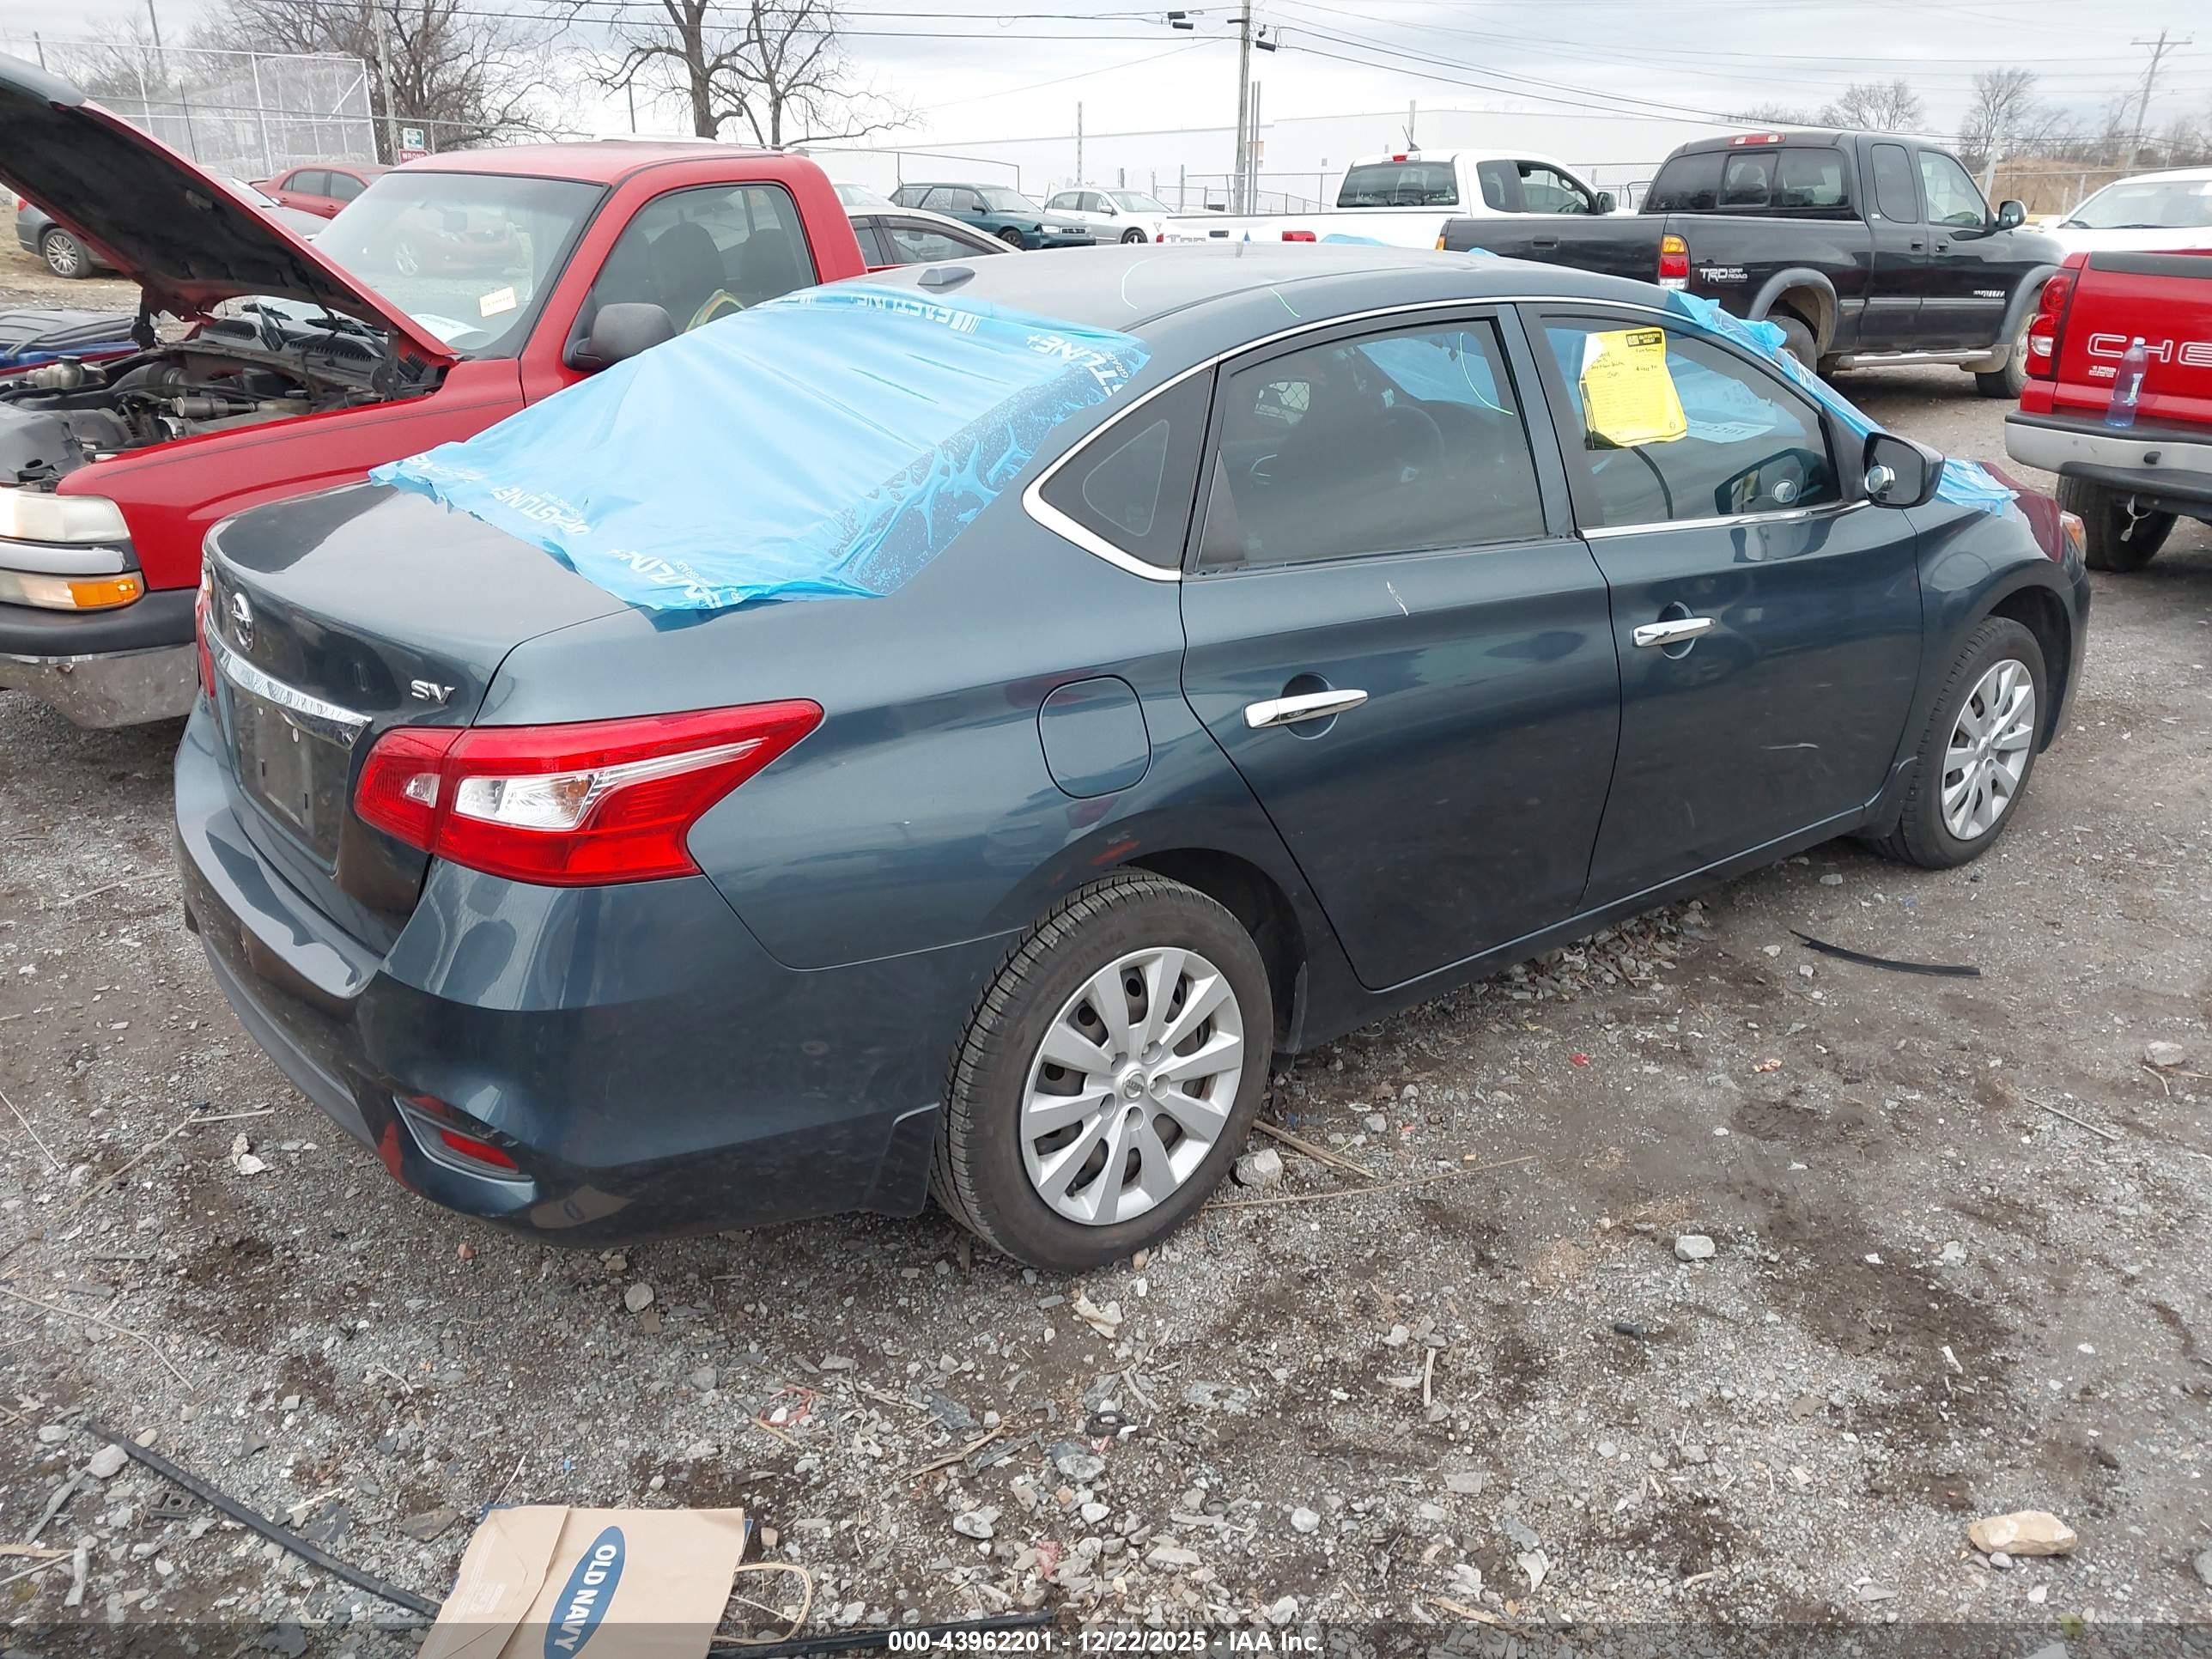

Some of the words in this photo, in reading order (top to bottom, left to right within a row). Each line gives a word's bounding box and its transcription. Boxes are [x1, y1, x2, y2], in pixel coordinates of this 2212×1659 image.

[1699, 268, 1729, 282] TRD
[411, 679, 455, 704] SV
[583, 1545, 617, 1585] OLD
[554, 1589, 599, 1651] NAVY
